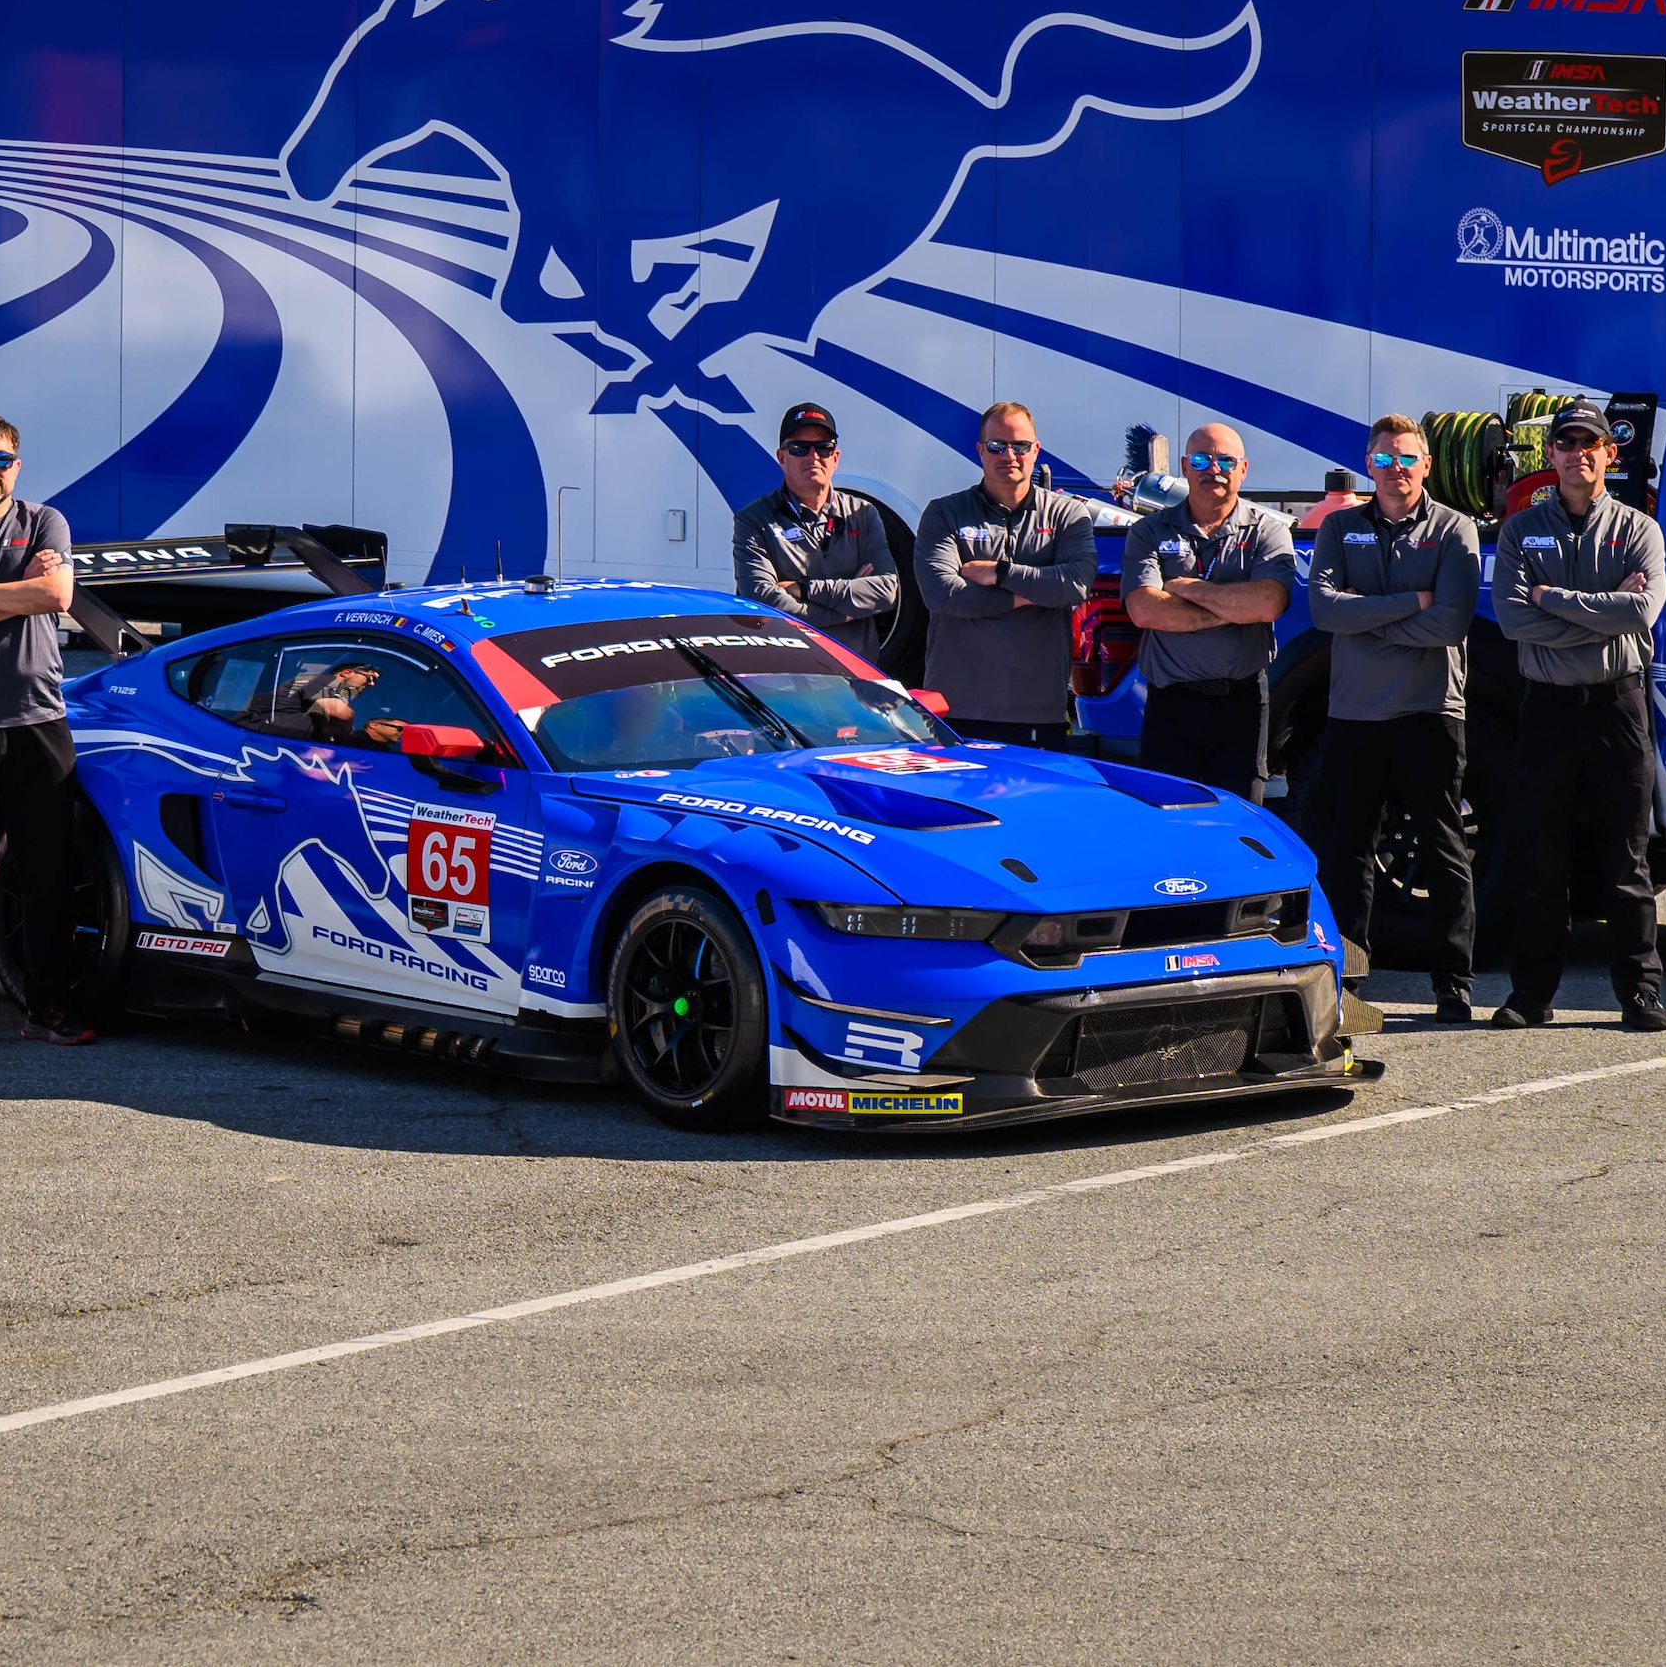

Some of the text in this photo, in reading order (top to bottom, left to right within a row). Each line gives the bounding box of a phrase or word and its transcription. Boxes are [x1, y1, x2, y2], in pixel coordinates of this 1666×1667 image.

[1549, 63, 1606, 81] IMSA
[1472, 90, 1660, 115] WeatherTech
[1504, 226, 1666, 264] Multimatic
[1504, 267, 1666, 294] MOTORSPORTS
[1522, 536, 1556, 547] AMR
[71, 546, 213, 566] TANG
[347, 612, 393, 627] VERVISCH
[423, 626, 446, 644] MIES
[540, 639, 665, 669] FORD
[417, 806, 492, 827] WeatherTech
[657, 792, 876, 846] FORD RACING
[421, 831, 476, 896] 65
[557, 852, 588, 872] Ford
[1164, 879, 1199, 893] Ford
[154, 937, 226, 954] GTD PRO
[312, 925, 488, 992] FORD RACING
[1182, 954, 1221, 968] IMSA
[528, 964, 566, 985] sparco
[788, 1091, 959, 1110] MOTUL MICHELIN
